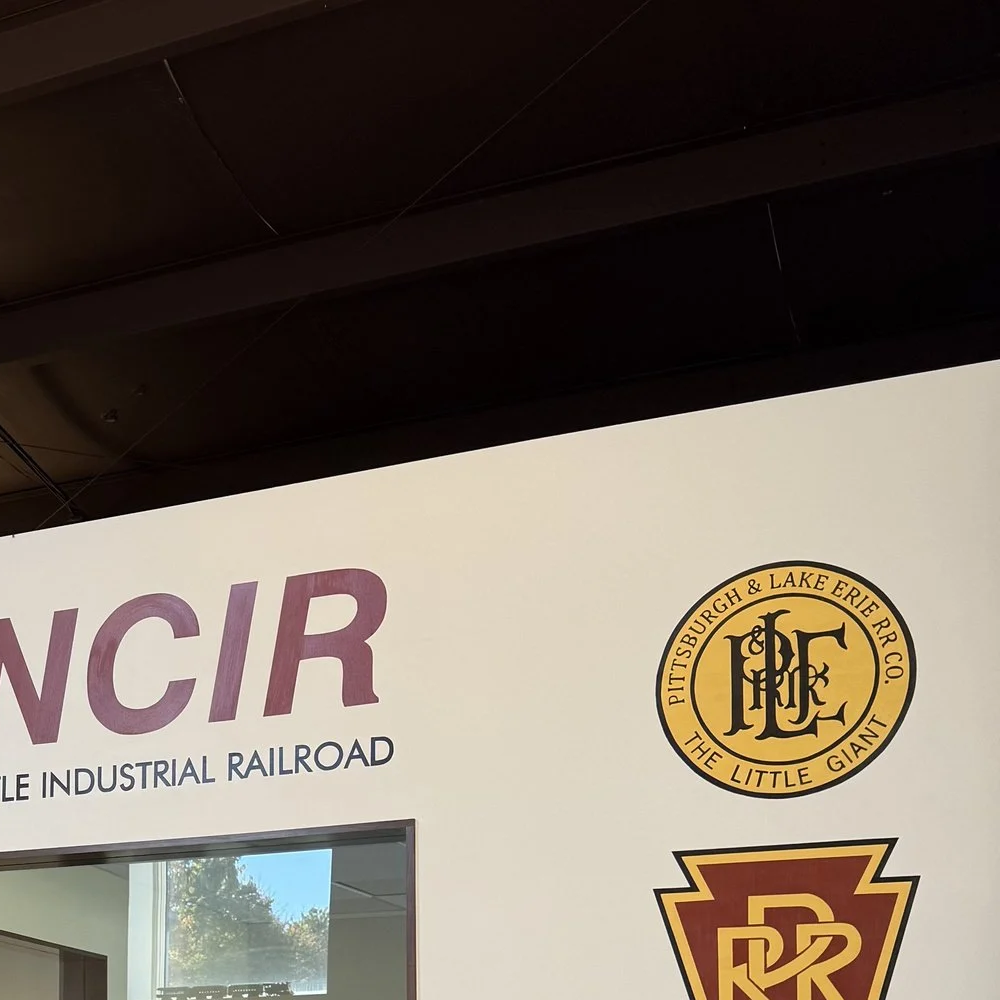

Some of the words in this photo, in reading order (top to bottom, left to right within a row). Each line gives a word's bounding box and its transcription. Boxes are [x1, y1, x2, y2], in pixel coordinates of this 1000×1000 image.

[747, 578, 763, 595] &
[769, 571, 829, 591] LAKE
[830, 579, 880, 618] ERIE
[668, 588, 743, 706] PITTSBURGH
[871, 617, 899, 649] RR
[883, 651, 904, 685] CO.
[42, 756, 215, 799] INDUSTRIAL
[227, 736, 394, 781] RAILROAD
[684, 731, 723, 770] THE
[730, 764, 813, 788] LITTLE
[826, 714, 888, 773] GIANT
